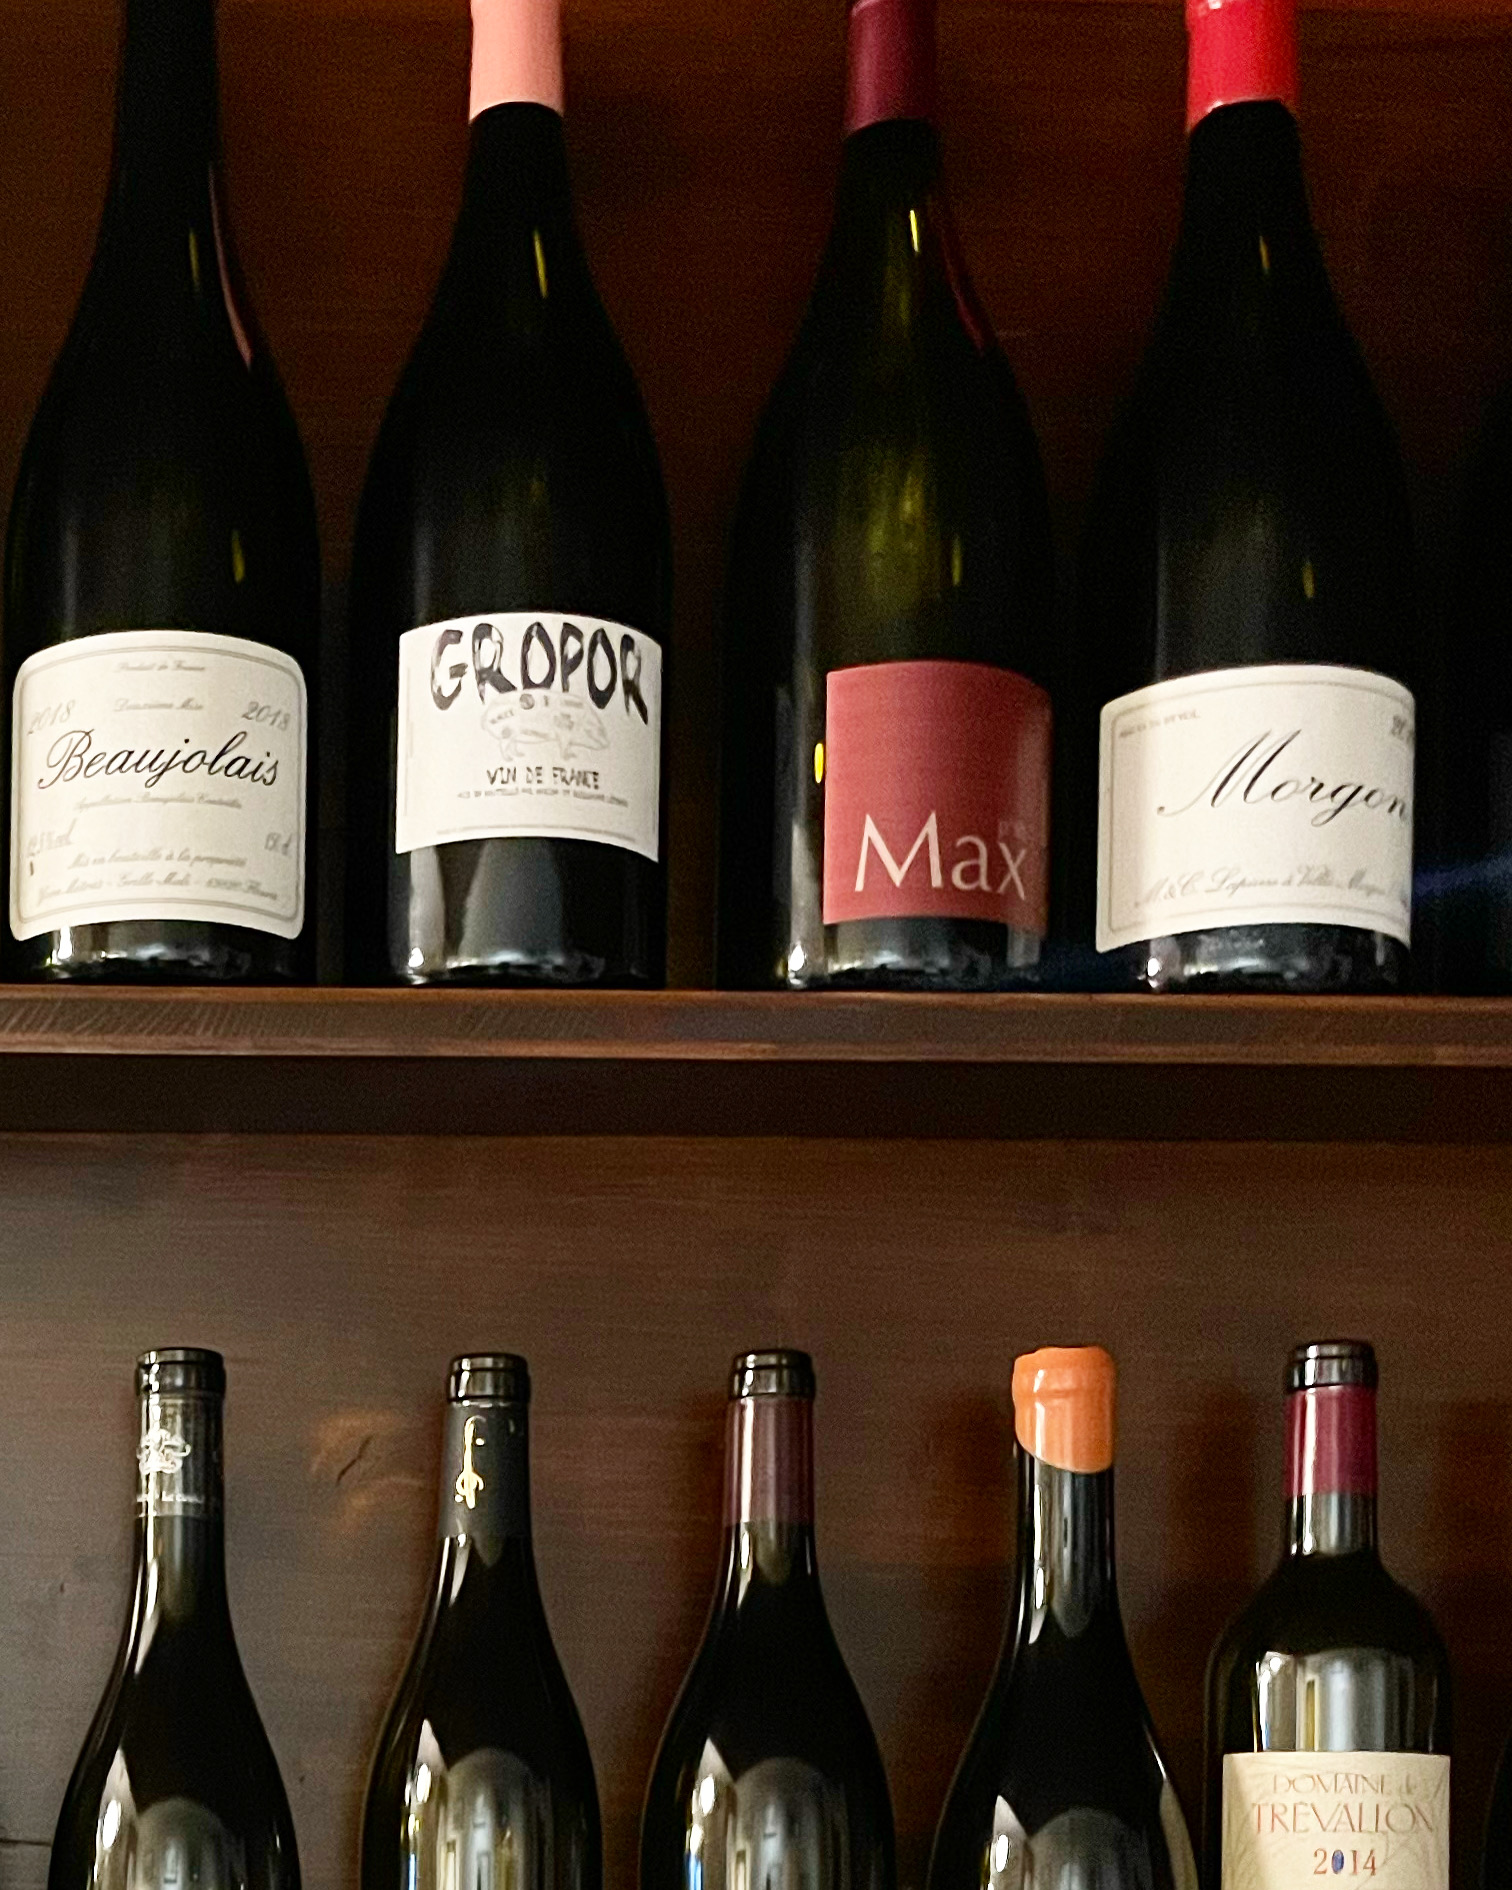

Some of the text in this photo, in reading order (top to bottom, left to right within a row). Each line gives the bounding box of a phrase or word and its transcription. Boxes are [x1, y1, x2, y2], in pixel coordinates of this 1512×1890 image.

[430, 621, 649, 726] GROPOR
[241, 700, 292, 732] 2018
[37, 728, 280, 790] Beaujolais
[487, 766, 517, 785] VIN
[526, 766, 543, 785] DE
[1156, 728, 1408, 828] Morgon
[854, 809, 1027, 900] Max
[1313, 1847, 1377, 1876] 2014
